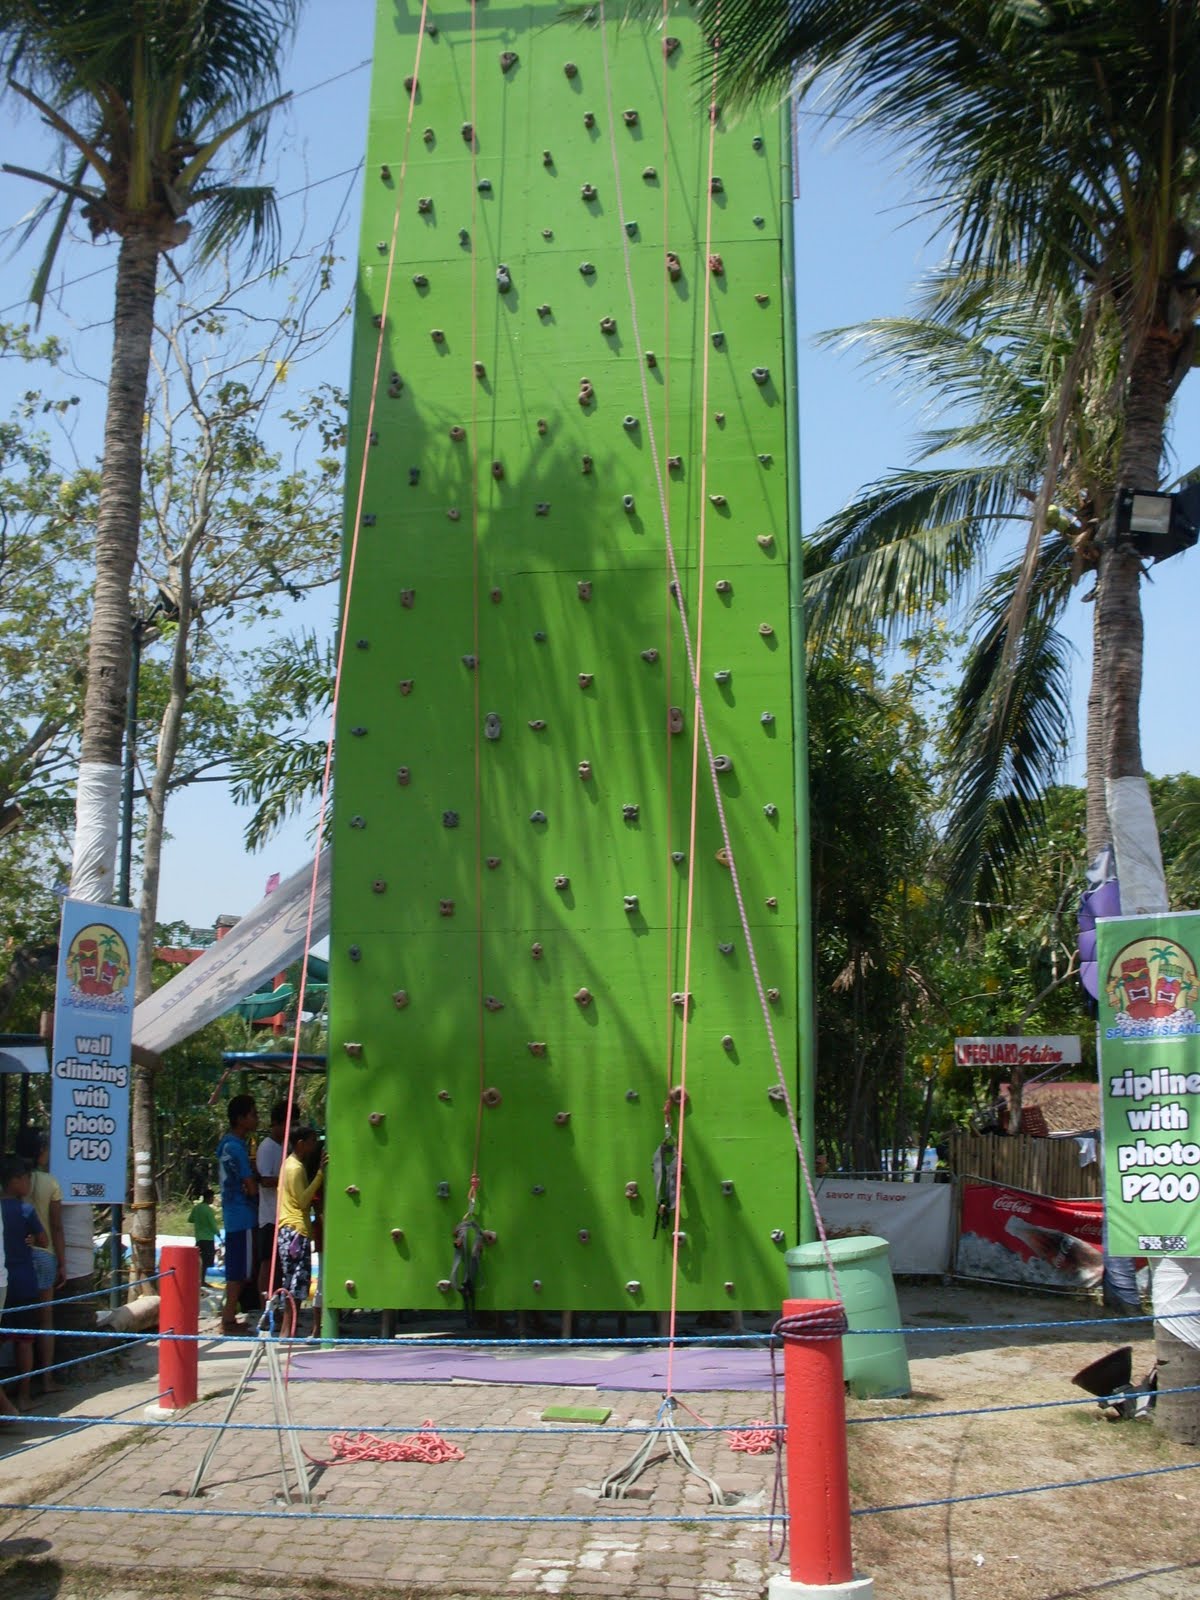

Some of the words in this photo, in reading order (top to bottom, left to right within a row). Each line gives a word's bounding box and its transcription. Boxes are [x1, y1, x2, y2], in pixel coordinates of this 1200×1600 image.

[1106, 1026, 1153, 1039] SPLASH
[75, 1035, 112, 1056] wall
[957, 1044, 1017, 1064] LIFEGUARD
[1018, 1044, 1062, 1065] Station
[56, 1057, 128, 1088] climbing
[1110, 1067, 1200, 1101] zipline
[73, 1085, 110, 1108] with
[65, 1111, 116, 1136] photo
[1127, 1102, 1189, 1131] with
[68, 1138, 111, 1161] P150
[1118, 1138, 1200, 1172] photo
[825, 1191, 855, 1199] savor
[856, 1192, 873, 1202] my
[876, 1192, 907, 1202] flavor
[1121, 1172, 1200, 1203] P200
